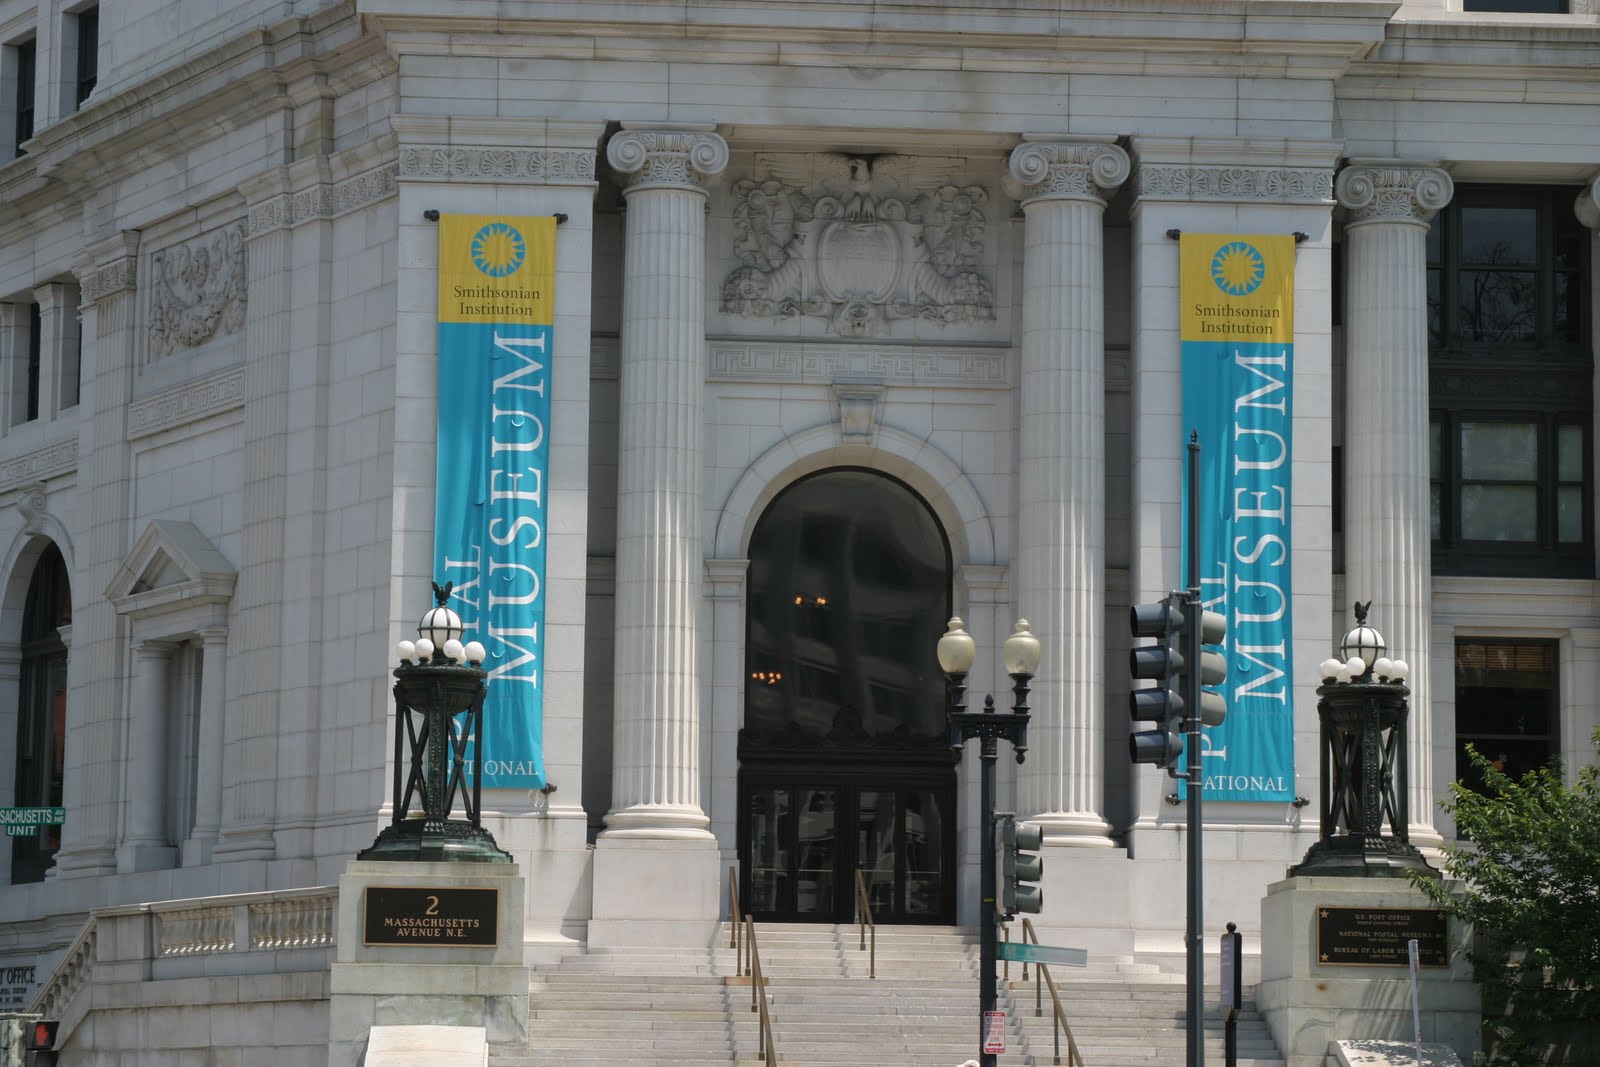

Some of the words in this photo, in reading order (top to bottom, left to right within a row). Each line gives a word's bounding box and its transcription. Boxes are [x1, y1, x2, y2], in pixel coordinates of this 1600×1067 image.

[454, 285, 540, 299] Smithsonian
[460, 302, 532, 316] Institution
[1195, 304, 1280, 318] Smithsonian
[1201, 320, 1273, 335] Institution
[486, 331, 545, 689] MUSEUM
[1233, 349, 1287, 705] MUSEUM
[1202, 775, 1288, 792] ATIONAL
[7, 825, 36, 836] UNIT
[425, 895, 439, 915] 2
[384, 918, 480, 928] MASSACHUSETTS
[396, 928, 441, 937] AVENUE
[446, 929, 468, 938] N.E.
[7, 968, 35, 984] OFFICE
